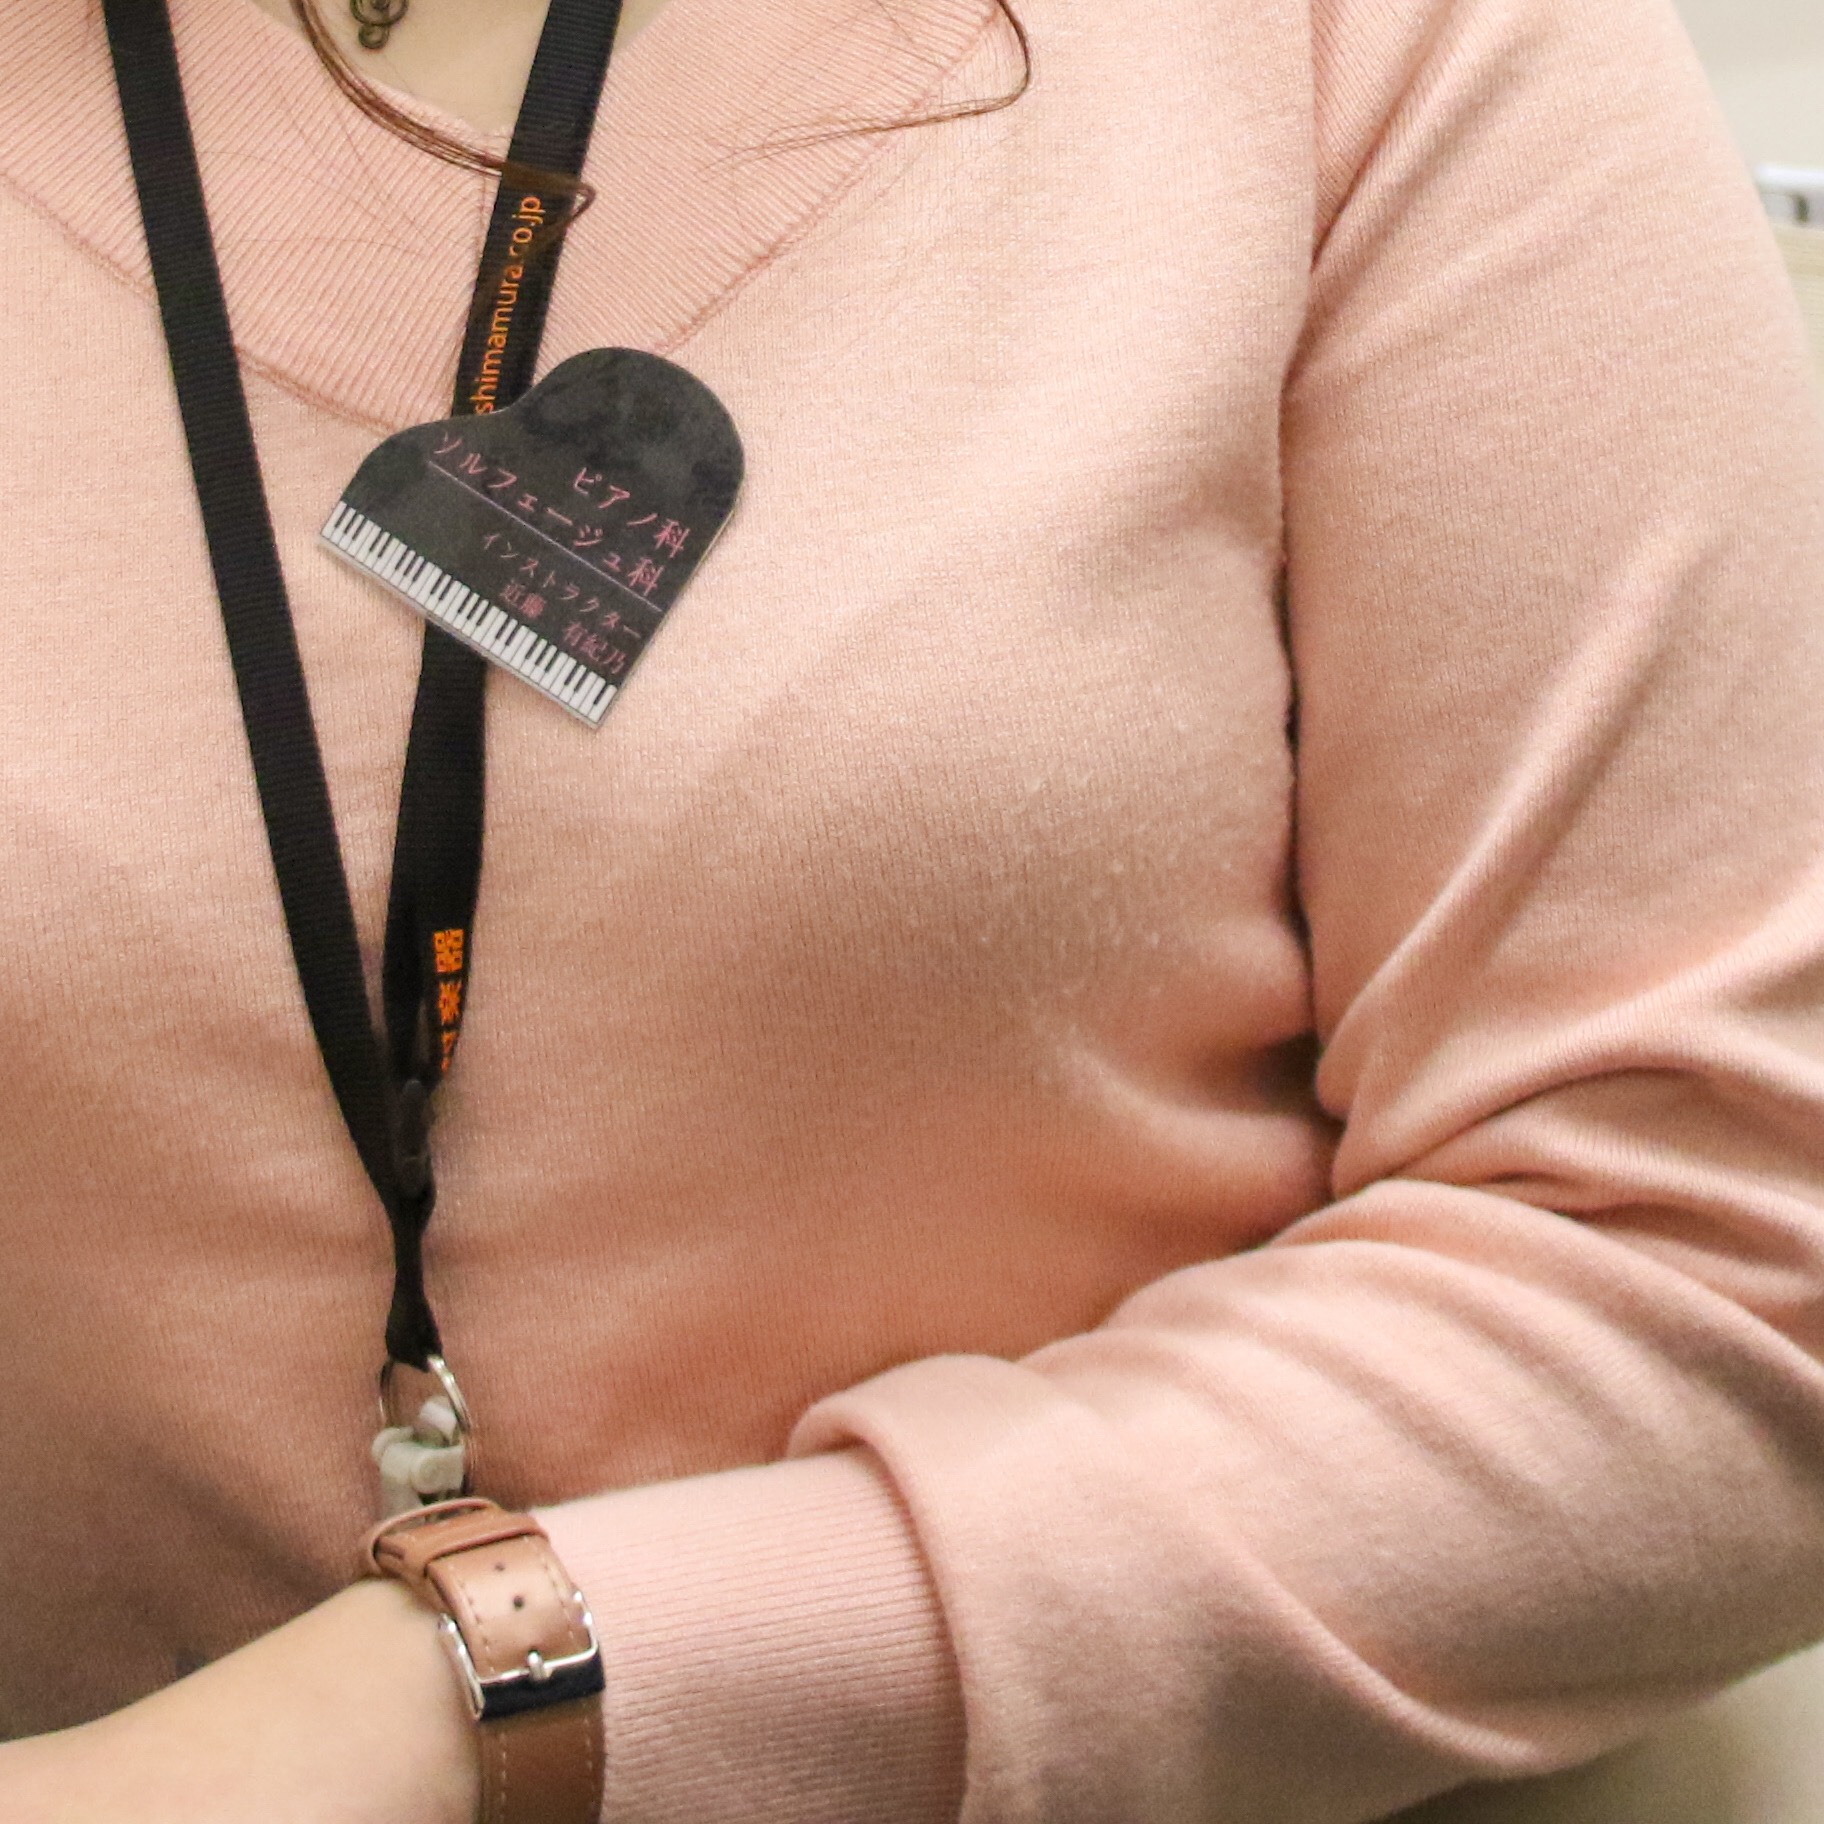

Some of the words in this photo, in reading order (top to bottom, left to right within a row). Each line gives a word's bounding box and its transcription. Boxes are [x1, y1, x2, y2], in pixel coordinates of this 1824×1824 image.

[470, 195, 547, 417] shimamurao.jp
[433, 432, 667, 597] ソルフェージュ科
[574, 466, 693, 558] ピアノ科
[484, 534, 642, 639] インストラクター
